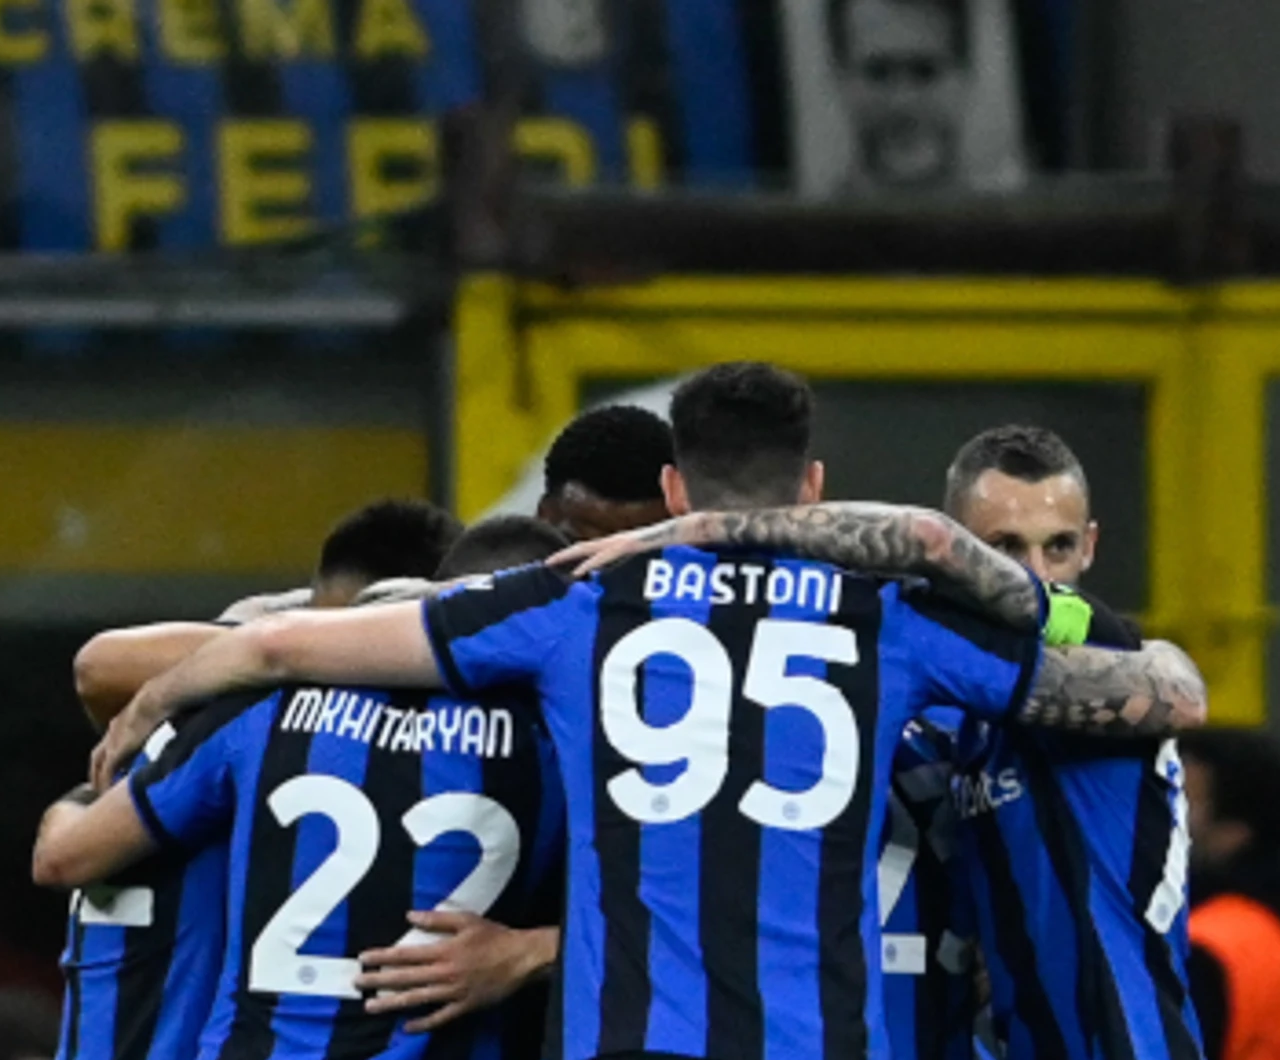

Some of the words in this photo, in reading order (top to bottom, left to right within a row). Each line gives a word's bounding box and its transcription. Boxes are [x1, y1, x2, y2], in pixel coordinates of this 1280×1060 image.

[643, 558, 843, 615] BASTONI
[280, 687, 514, 759] MKHITARYAN
[599, 616, 862, 832] 95
[248, 773, 521, 1000] 22
